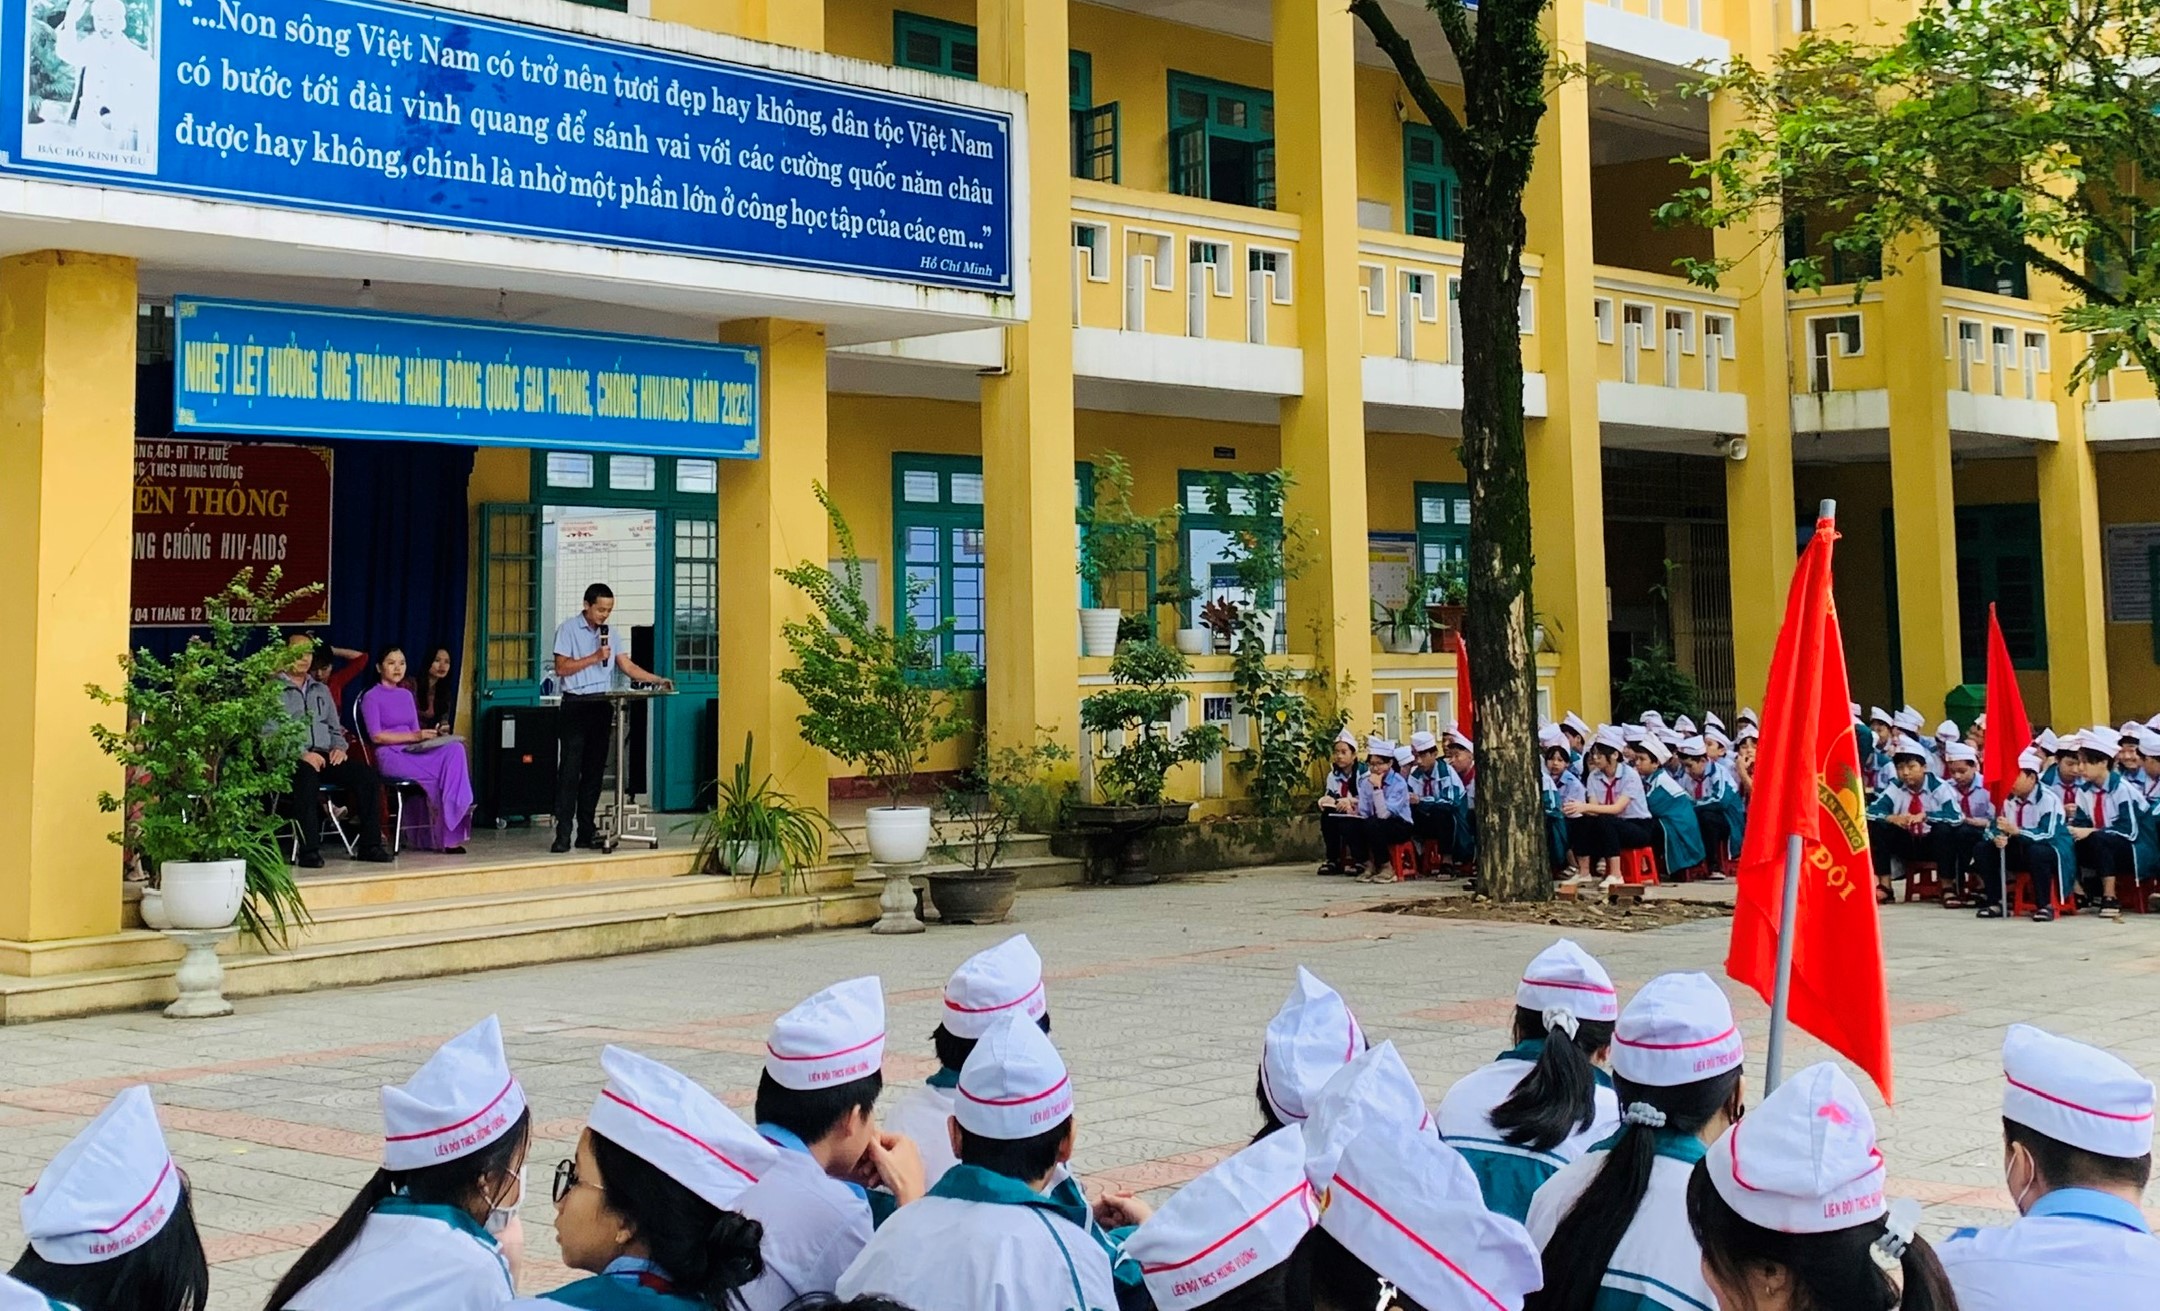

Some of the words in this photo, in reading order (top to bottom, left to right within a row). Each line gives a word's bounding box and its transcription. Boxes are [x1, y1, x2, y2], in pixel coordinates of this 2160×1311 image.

[285, 14, 352, 57] sông
[358, 23, 413, 67] Việt
[419, 35, 481, 72] Nam
[486, 51, 515, 78] có
[521, 55, 559, 86] trở
[564, 63, 608, 95] nên
[613, 74, 660, 103] tươi
[665, 79, 707, 116] đẹp
[711, 87, 751, 124] hay
[756, 94, 828, 136] không,
[831, 109, 870, 138] dân
[873, 117, 904, 149] tộc
[908, 121, 947, 157] Việt
[950, 129, 994, 159] Nam
[177, 55, 211, 87] có
[221, 58, 292, 99] bước
[301, 74, 339, 106] tới
[349, 81, 392, 114] đài
[401, 90, 461, 125] vinh
[470, 107, 550, 145] quang
[556, 110, 587, 144] để
[593, 122, 649, 153] sánh
[656, 134, 691, 160] vai
[698, 138, 732, 165] với
[738, 144, 774, 172] các
[780, 152, 843, 188] cường
[848, 161, 896, 191] quốc
[901, 171, 943, 197] năm
[948, 176, 993, 205] châu
[175, 112, 249, 159] được
[254, 123, 308, 166] hay
[312, 130, 408, 179] không,
[412, 148, 487, 184] chính
[491, 157, 515, 188] là
[518, 162, 567, 194] nhờ
[569, 172, 617, 208] một
[620, 175, 679, 209] phần
[682, 183, 718, 214] lớn
[721, 187, 735, 216] ở
[737, 192, 788, 229] công
[790, 199, 828, 234] học
[830, 207, 863, 239] tập
[866, 209, 902, 239] của
[903, 217, 936, 243] các
[940, 259, 962, 273] Chí
[962, 261, 993, 277] Minh
[184, 331, 230, 407] NHIỆT
[233, 334, 264, 408] LIỆT
[267, 330, 318, 399] HƯỞNG
[321, 339, 352, 401] ỨNG
[355, 343, 401, 405] THÁNG
[404, 346, 442, 408] HÀNH
[445, 350, 482, 420] ĐỘNG
[485, 347, 520, 417] QUỐC
[523, 365, 545, 413] GIA
[597, 355, 637, 419] CHỐNG
[692, 370, 720, 425] NĂM
[151, 462, 178, 477] THCS
[184, 480, 289, 517] THÔNG
[162, 522, 212, 560] CHỐNG
[220, 532, 288, 561] HIV-AIDS
[135, 607, 149, 622] 04
[151, 603, 186, 621] THÁNG
[190, 607, 202, 621] 12
[1810, 843, 1857, 902] ĐỘI
